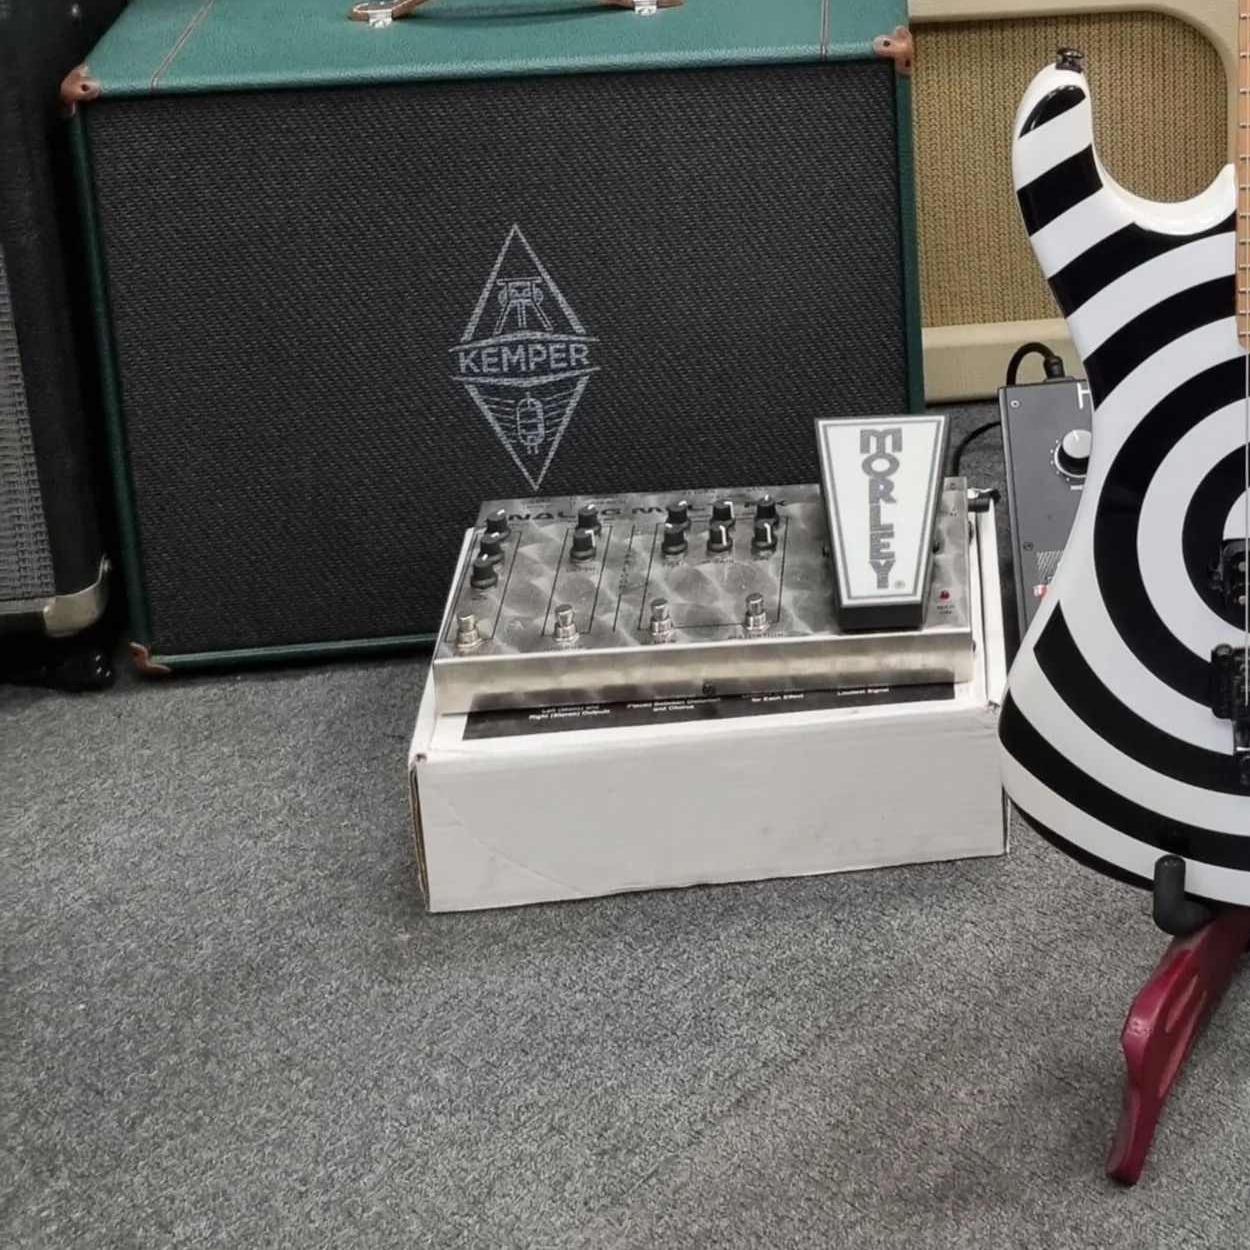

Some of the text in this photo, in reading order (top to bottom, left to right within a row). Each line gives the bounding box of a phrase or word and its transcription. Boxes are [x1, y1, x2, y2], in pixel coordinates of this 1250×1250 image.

[459, 343, 590, 374] KEMPER
[859, 427, 903, 591] MORLEY
[529, 712, 550, 720] Right
